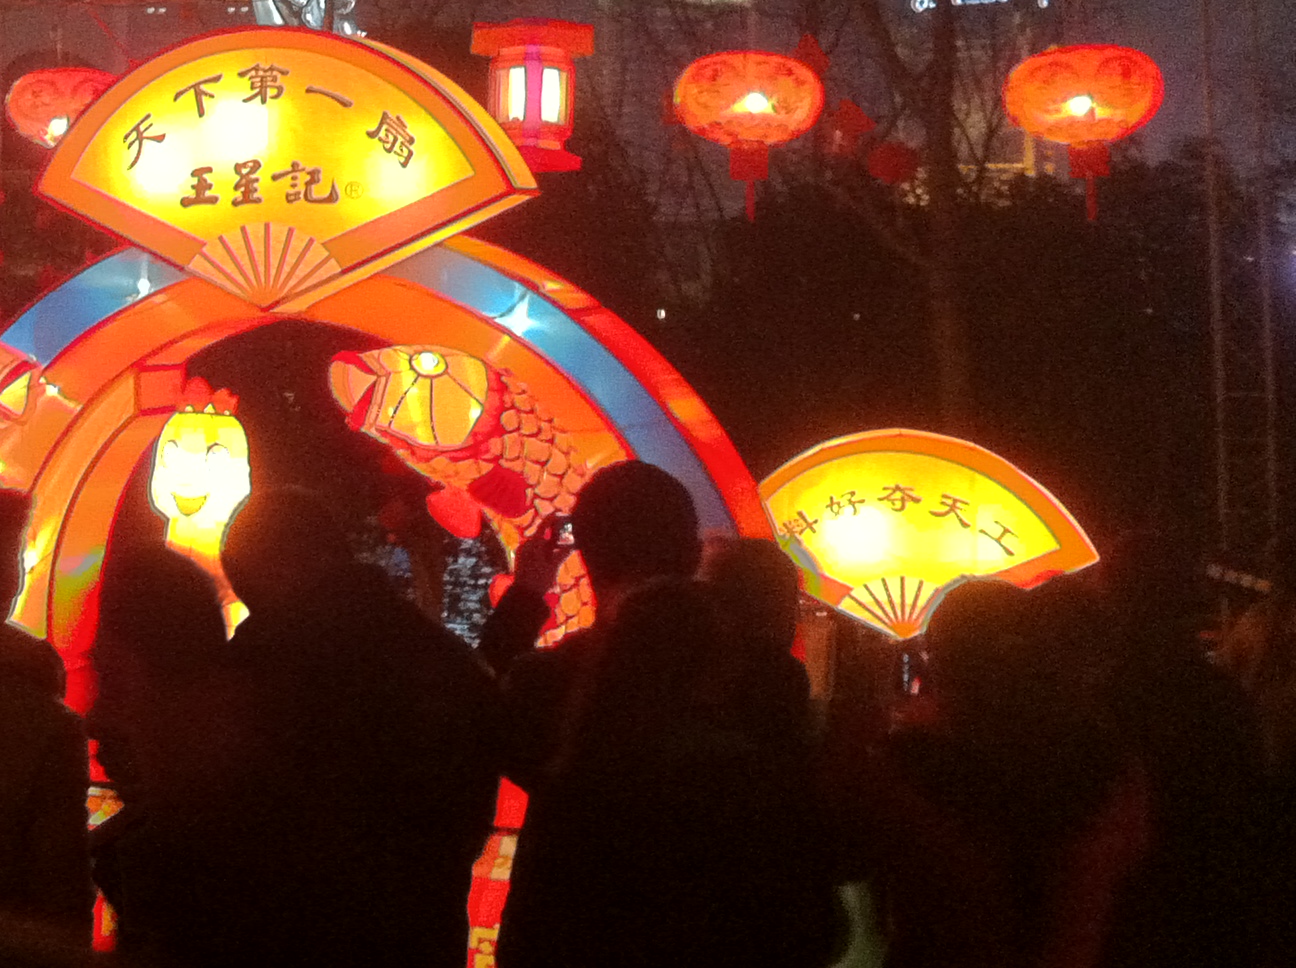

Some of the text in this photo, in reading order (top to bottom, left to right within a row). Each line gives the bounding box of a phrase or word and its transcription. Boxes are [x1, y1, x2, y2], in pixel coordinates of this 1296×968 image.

[122, 62, 416, 170] 天下第一扇
